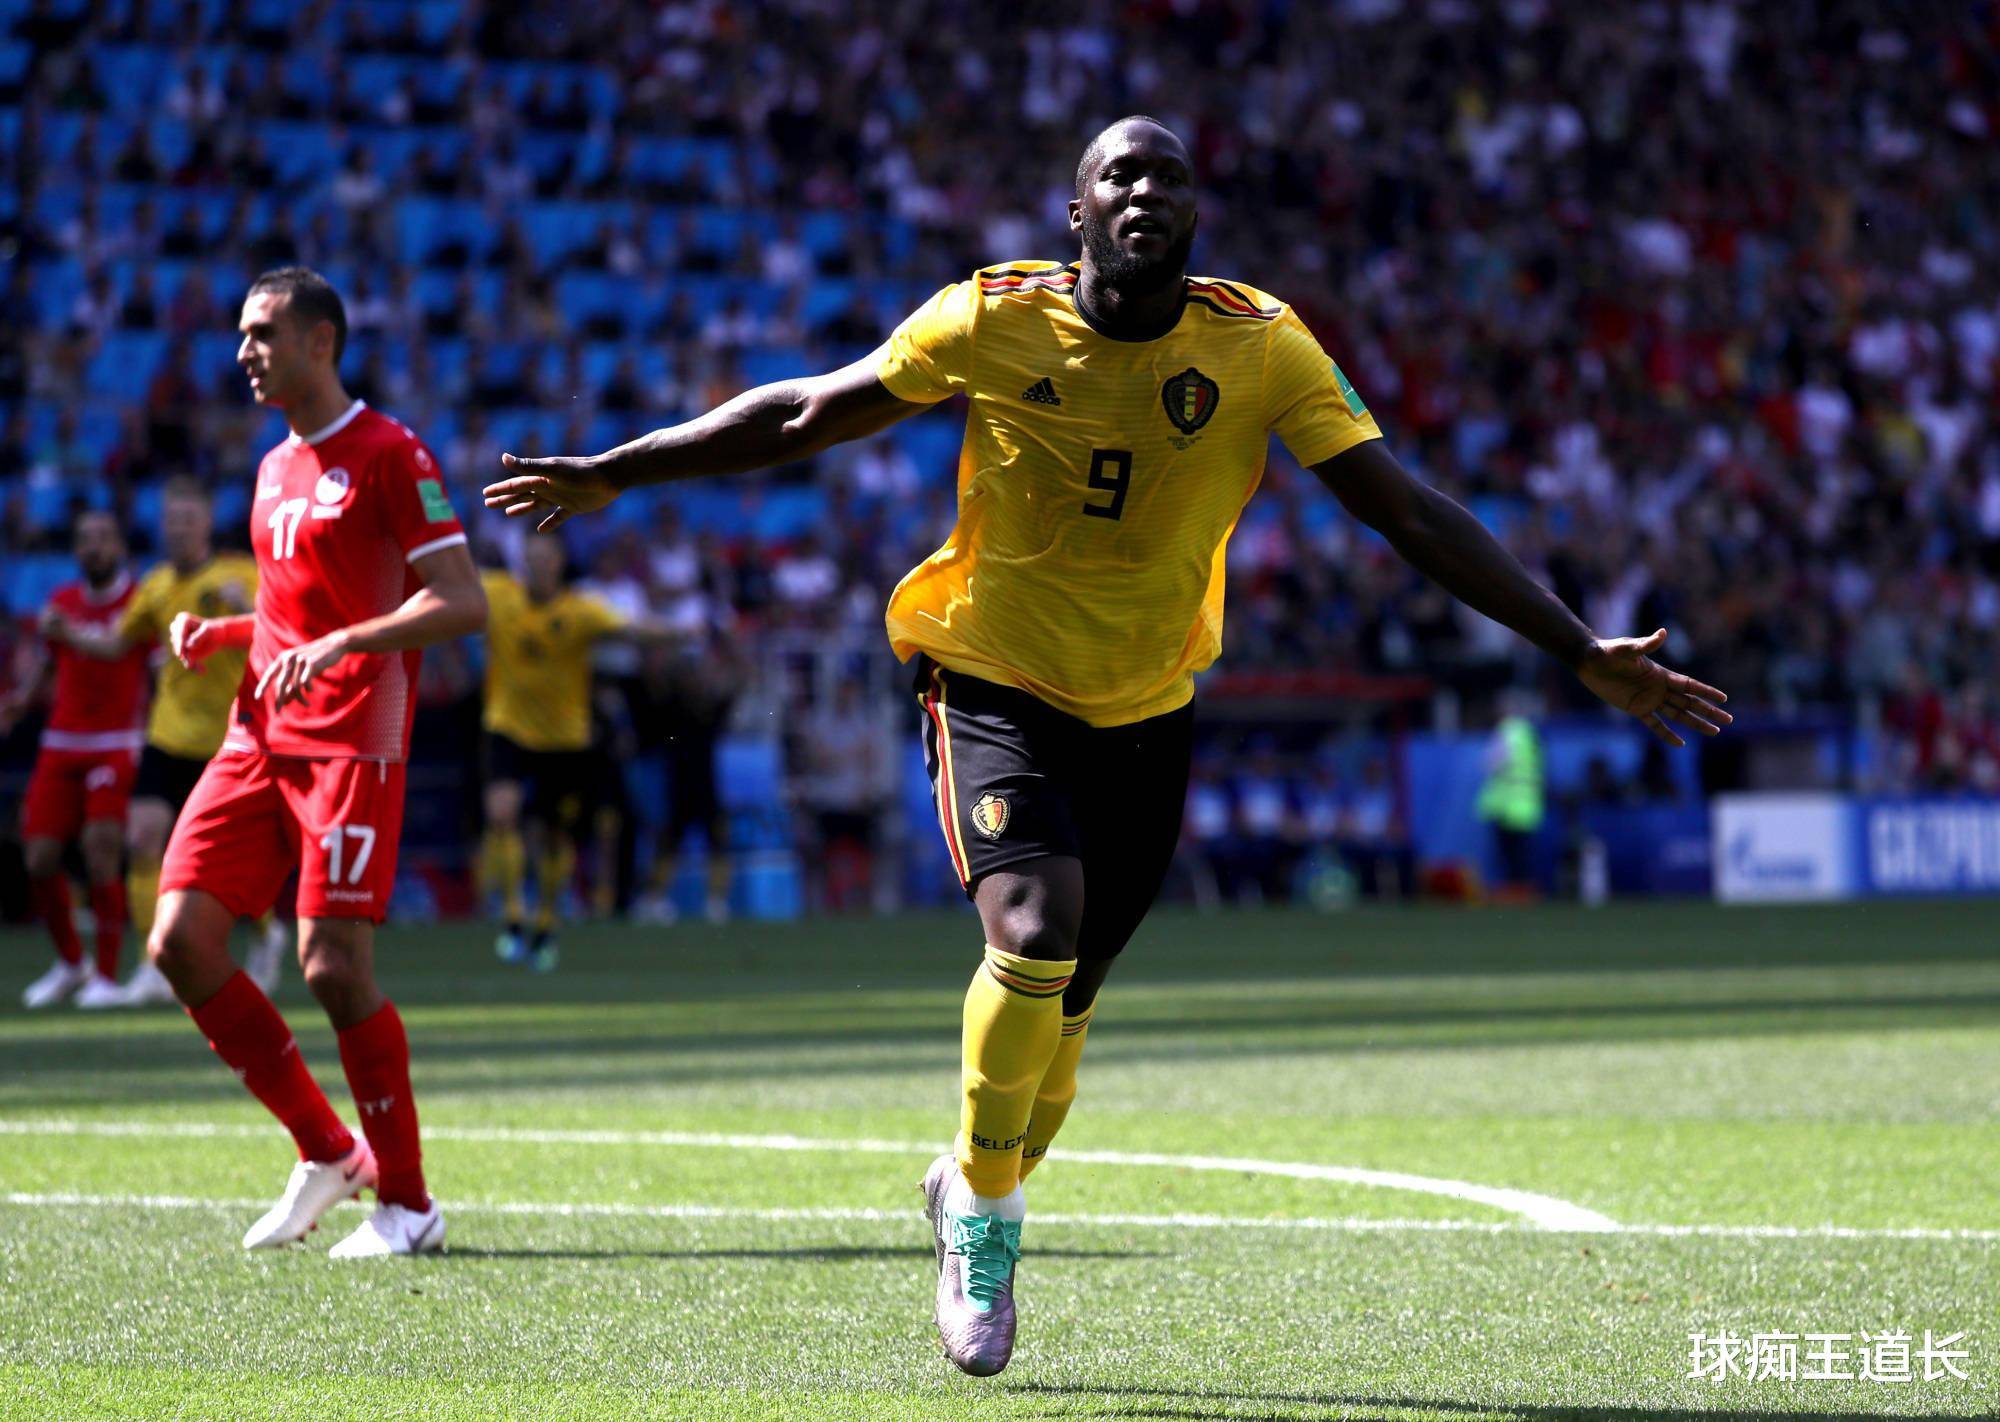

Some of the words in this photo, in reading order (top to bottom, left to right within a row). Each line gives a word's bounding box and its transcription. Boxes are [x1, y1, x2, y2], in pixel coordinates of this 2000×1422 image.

[1083, 448, 1133, 521] 9
[267, 497, 308, 561] 17
[320, 825, 376, 886] 17
